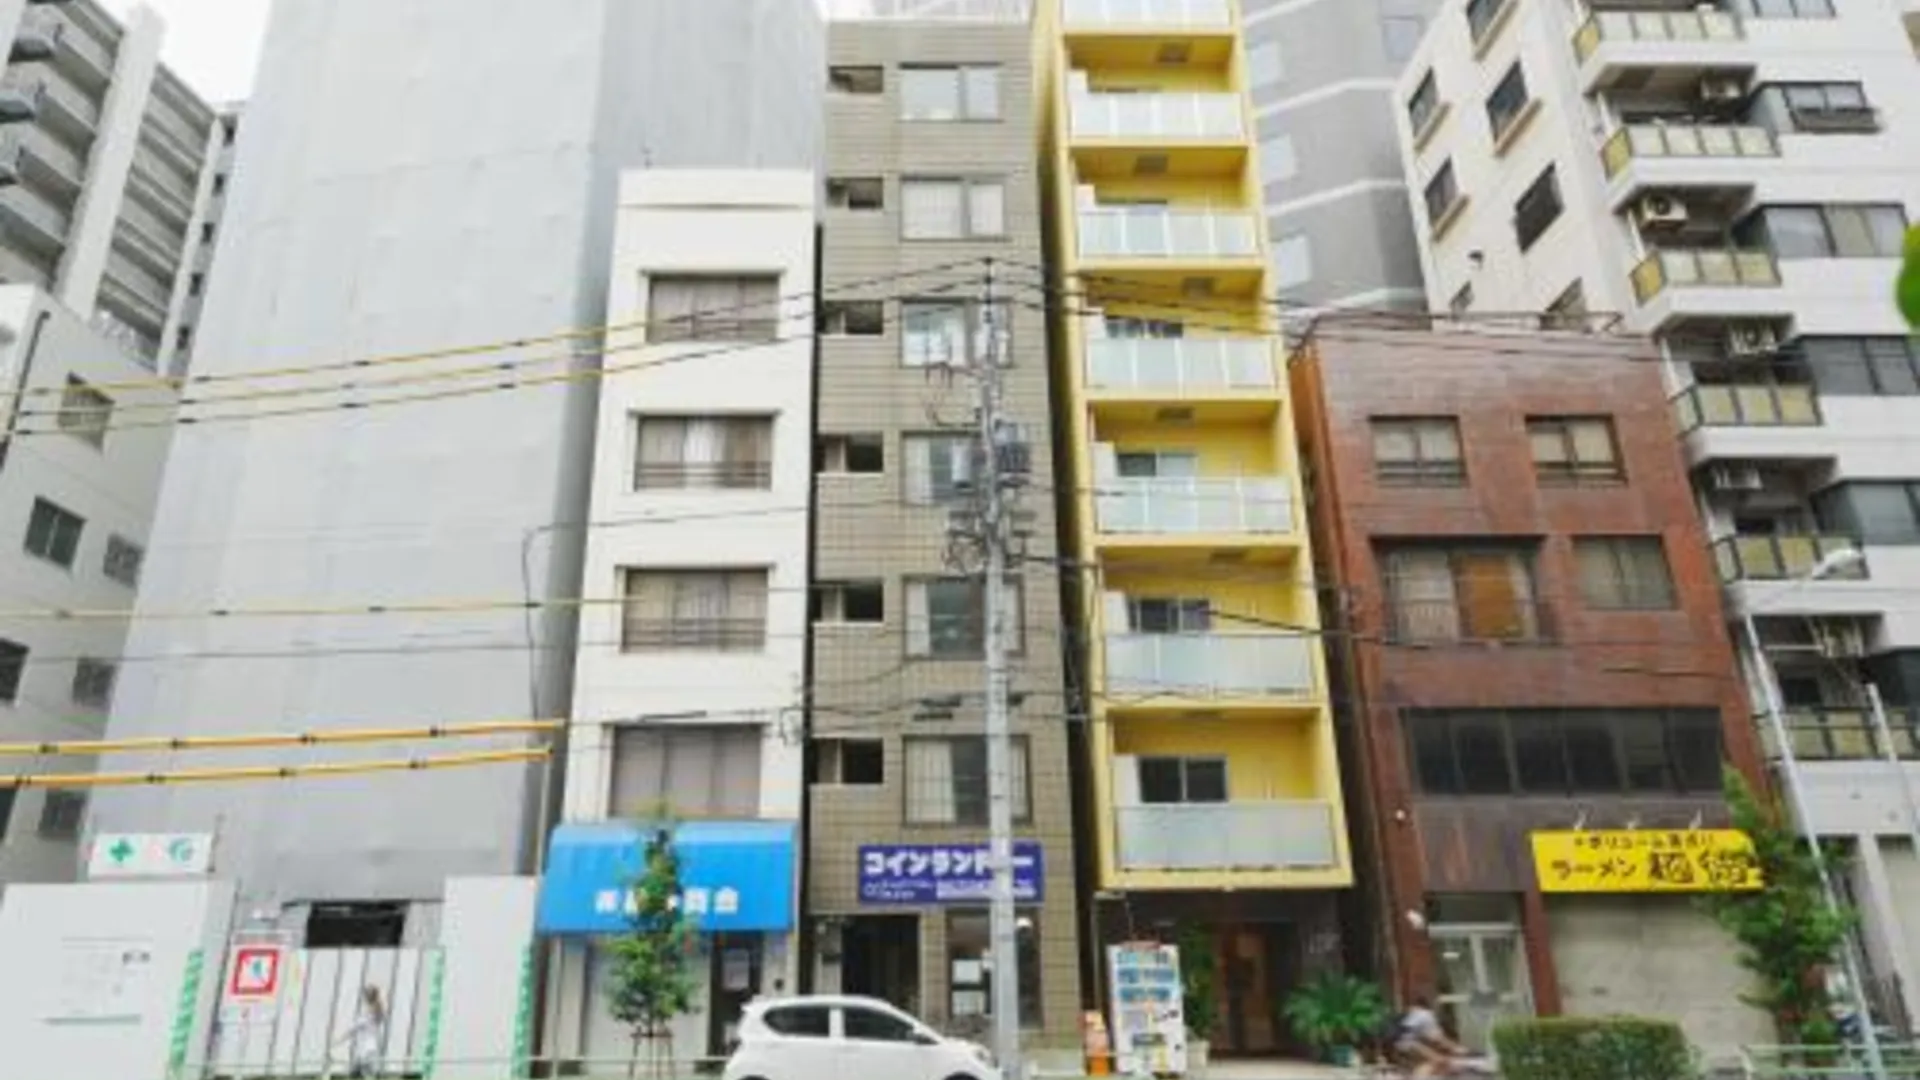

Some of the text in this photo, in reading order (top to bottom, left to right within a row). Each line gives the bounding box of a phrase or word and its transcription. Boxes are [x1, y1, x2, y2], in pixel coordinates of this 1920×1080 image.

[864, 851, 1034, 876] コインランドー
[1551, 859, 1637, 880] ラーメン
